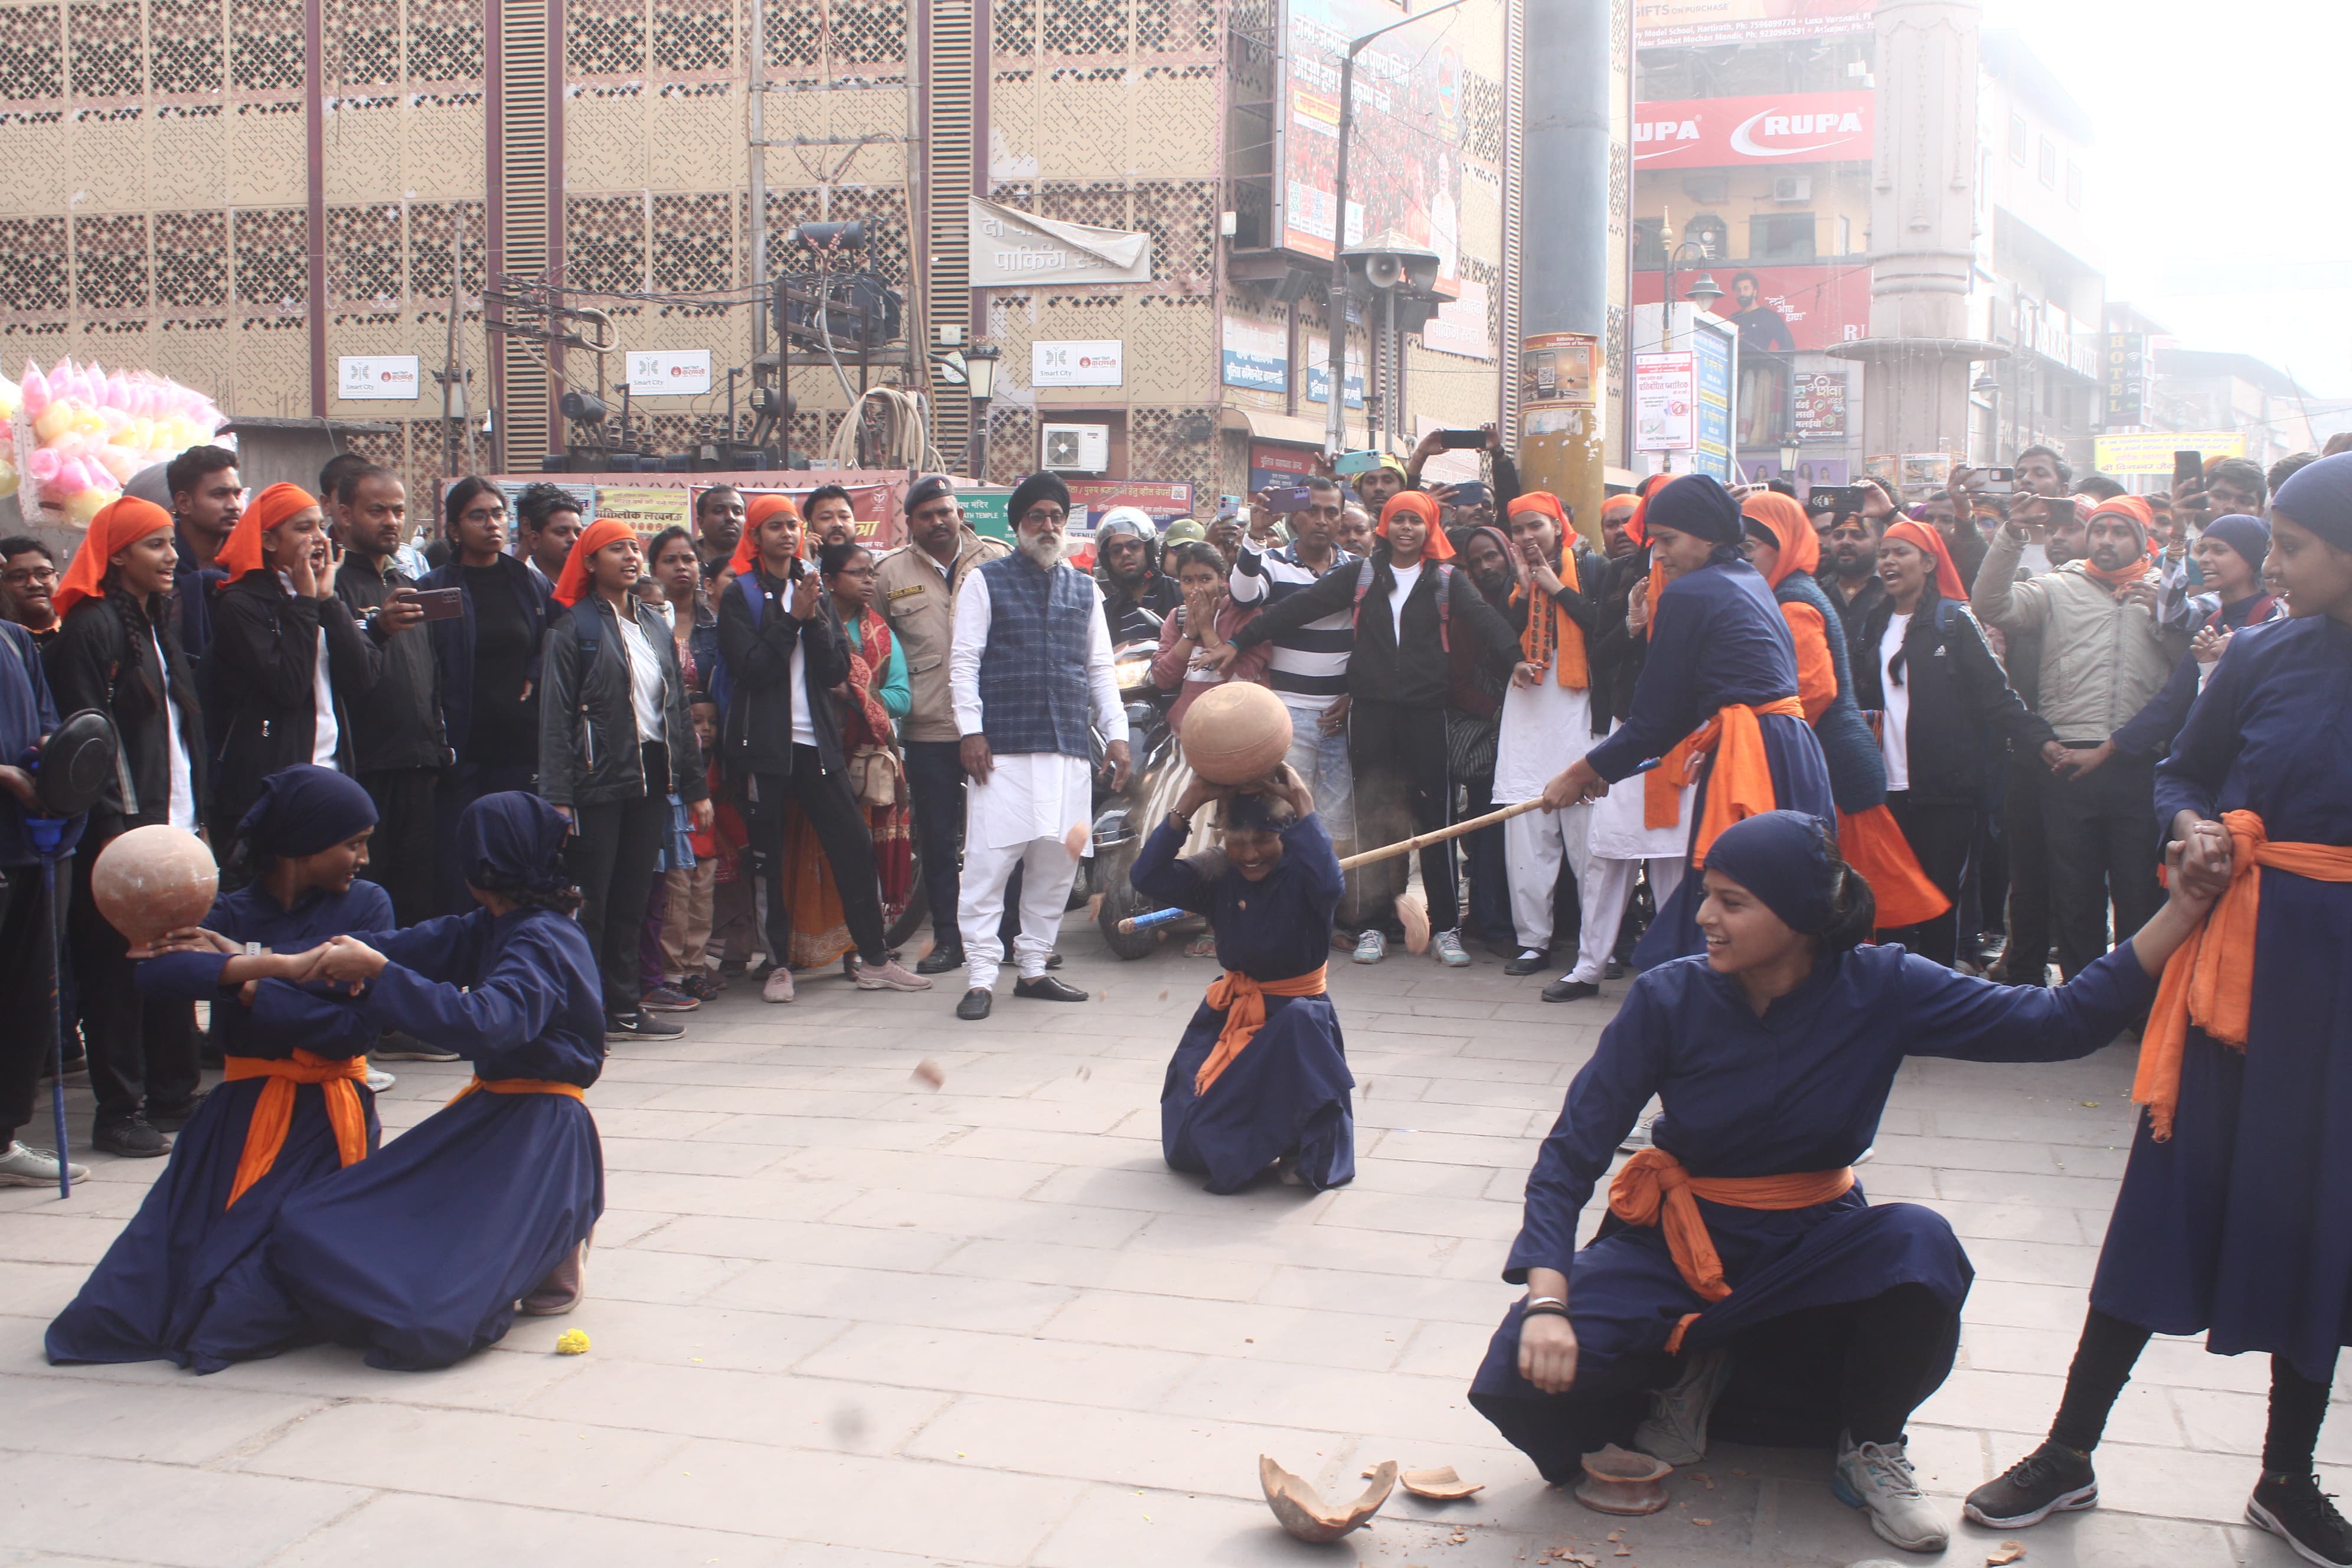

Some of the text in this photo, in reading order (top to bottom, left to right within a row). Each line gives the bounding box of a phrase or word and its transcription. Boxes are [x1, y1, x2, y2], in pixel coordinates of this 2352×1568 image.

[1637, 39, 1655, 47] Near
[1657, 36, 1682, 46] Sankat
[1683, 34, 1713, 44] Mochan
[1759, 27, 1805, 38] 9230985291
[1645, 30, 1667, 38] Model
[1750, 19, 1796, 29] 7596099770
[1804, 17, 1824, 25] Luxa
[1634, 112, 1863, 142] UPA RUPA
[2108, 335, 2125, 412] HOTEL
[971, 499, 989, 509] मंदिर
[643, 512, 684, 521] लखनऊ
